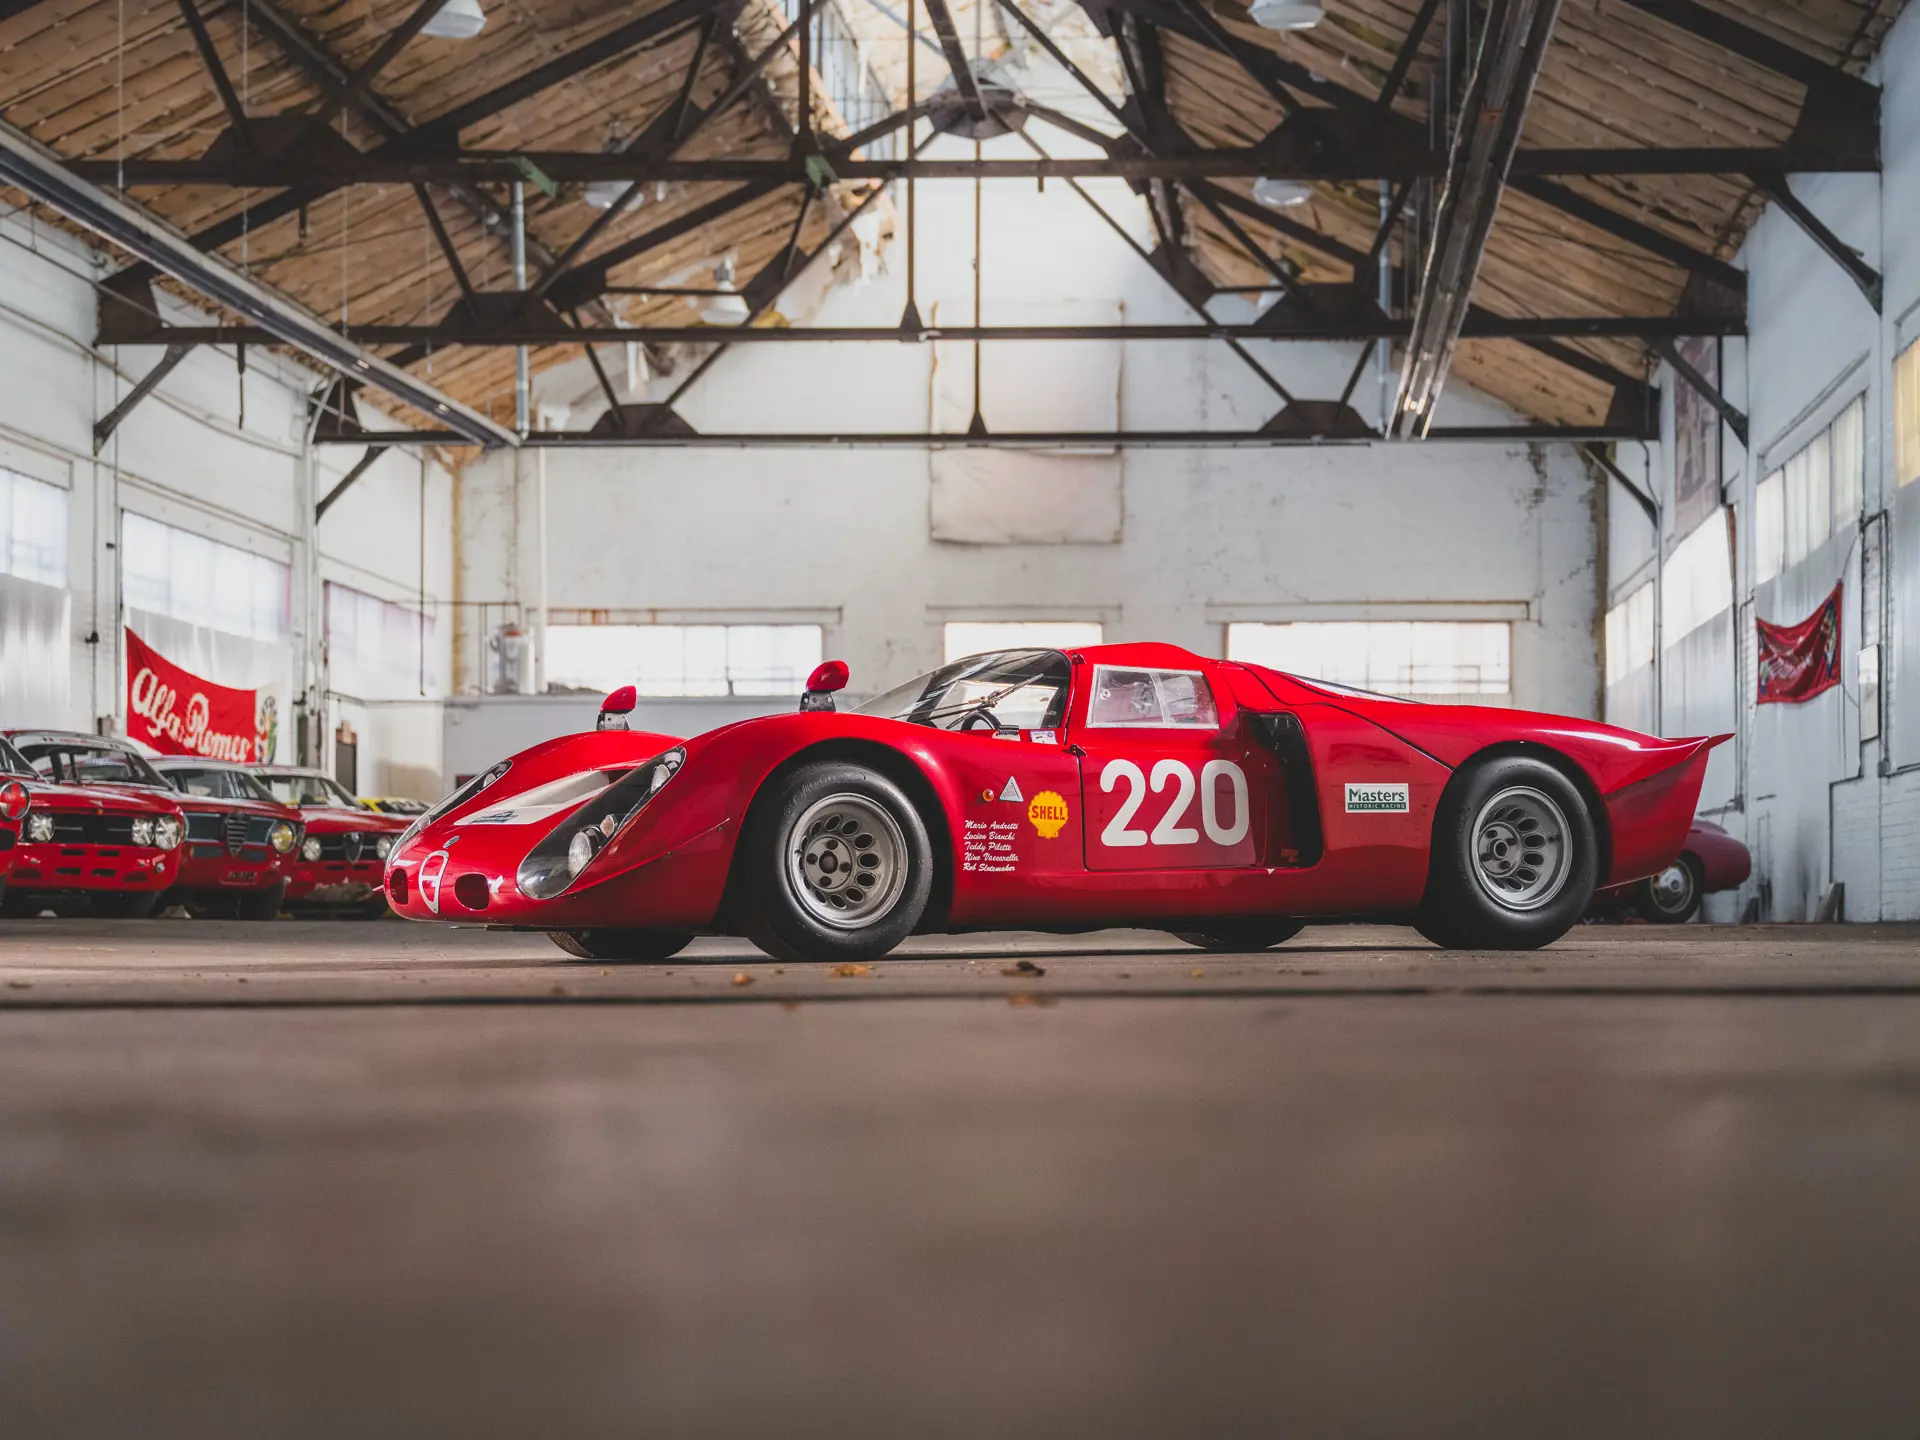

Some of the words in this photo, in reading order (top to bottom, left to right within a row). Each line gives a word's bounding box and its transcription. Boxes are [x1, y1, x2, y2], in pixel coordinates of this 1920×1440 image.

[131, 668, 184, 742] Alfa
[183, 692, 251, 762] Romeo
[1348, 788, 1405, 802] Masters
[1100, 758, 1250, 847] 220
[1031, 805, 1066, 820] SHELL
[964, 820, 987, 829] Mario
[989, 820, 1019, 830] Andretti
[963, 831, 987, 840] Lucien
[989, 831, 1016, 840] Bianchi
[964, 841, 986, 852] Teddy
[988, 841, 1012, 851] Pilette
[964, 852, 981, 861] Nino
[983, 852, 1019, 862] Vaccarella
[963, 862, 977, 871] Rob
[978, 863, 1016, 872] Slotemaker
